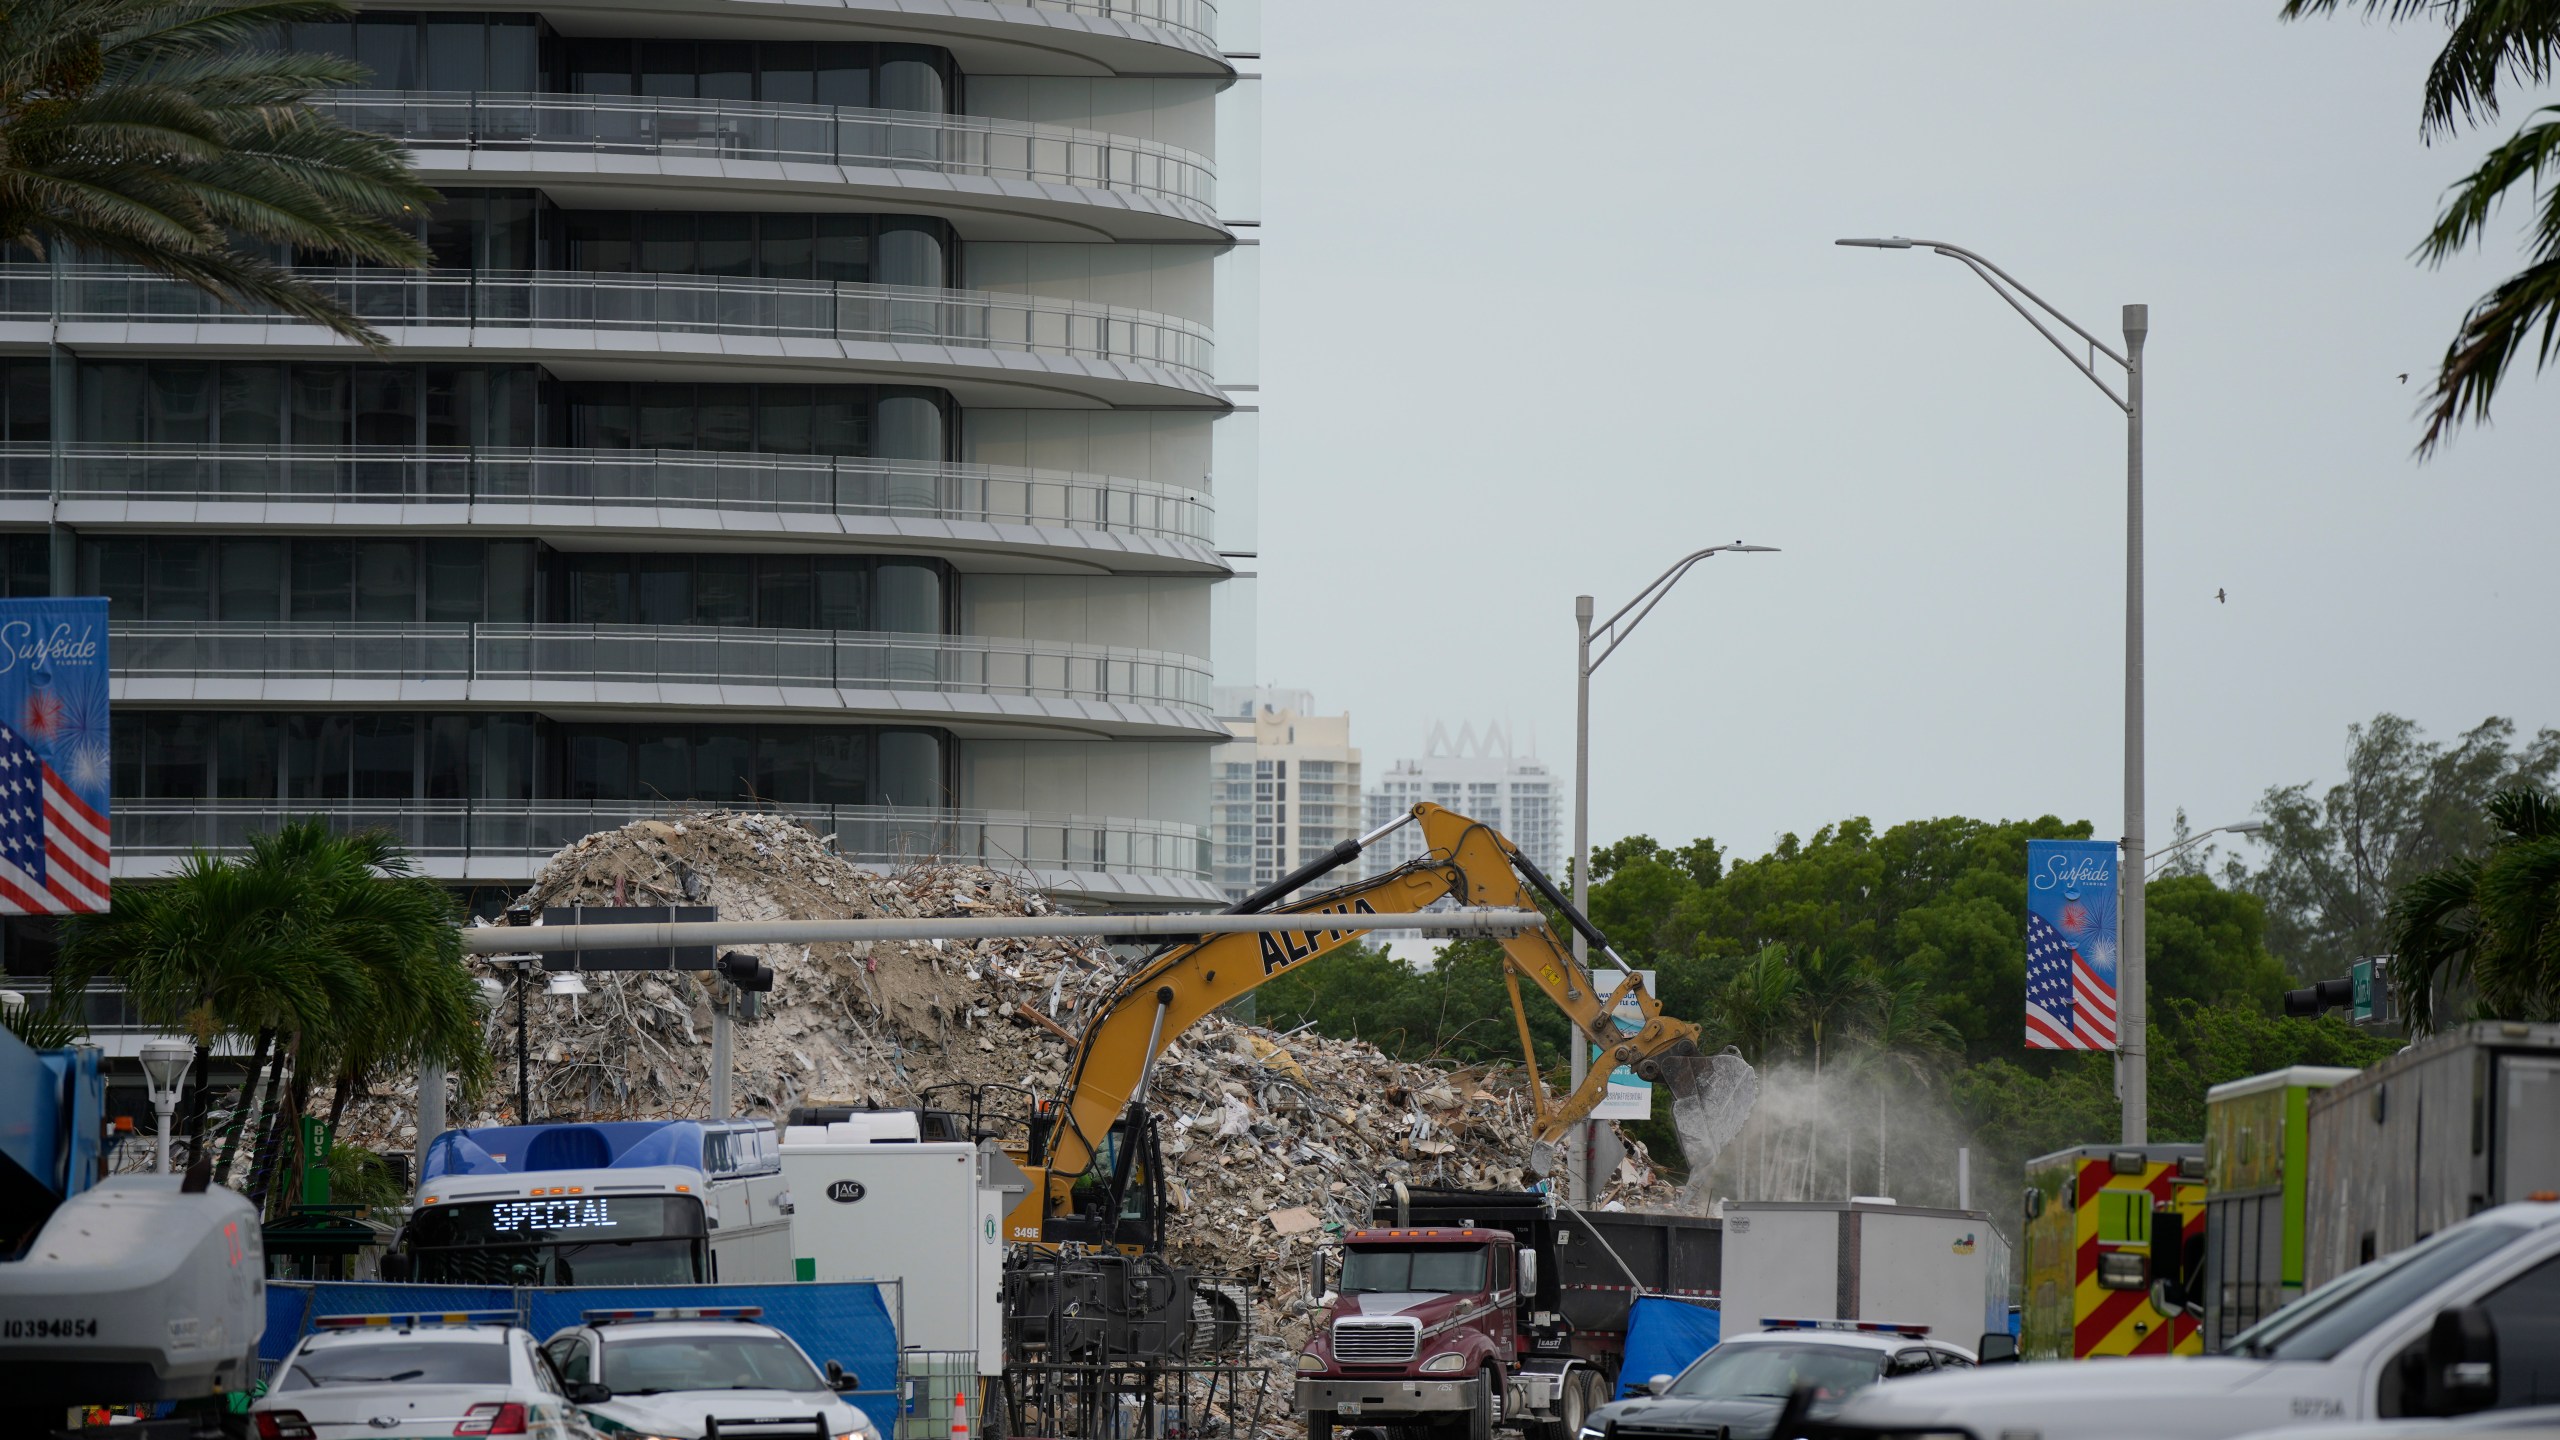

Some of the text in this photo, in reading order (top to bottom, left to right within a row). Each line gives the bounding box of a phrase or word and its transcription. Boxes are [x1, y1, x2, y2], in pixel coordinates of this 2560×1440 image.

[0, 621, 96, 674] Surfside
[2034, 854, 2109, 890] Surfside
[314, 1125, 324, 1157] BUS
[834, 1183, 859, 1200] JAG
[493, 1199, 617, 1231] SPECIAL
[1014, 1227, 1039, 1239] 349E
